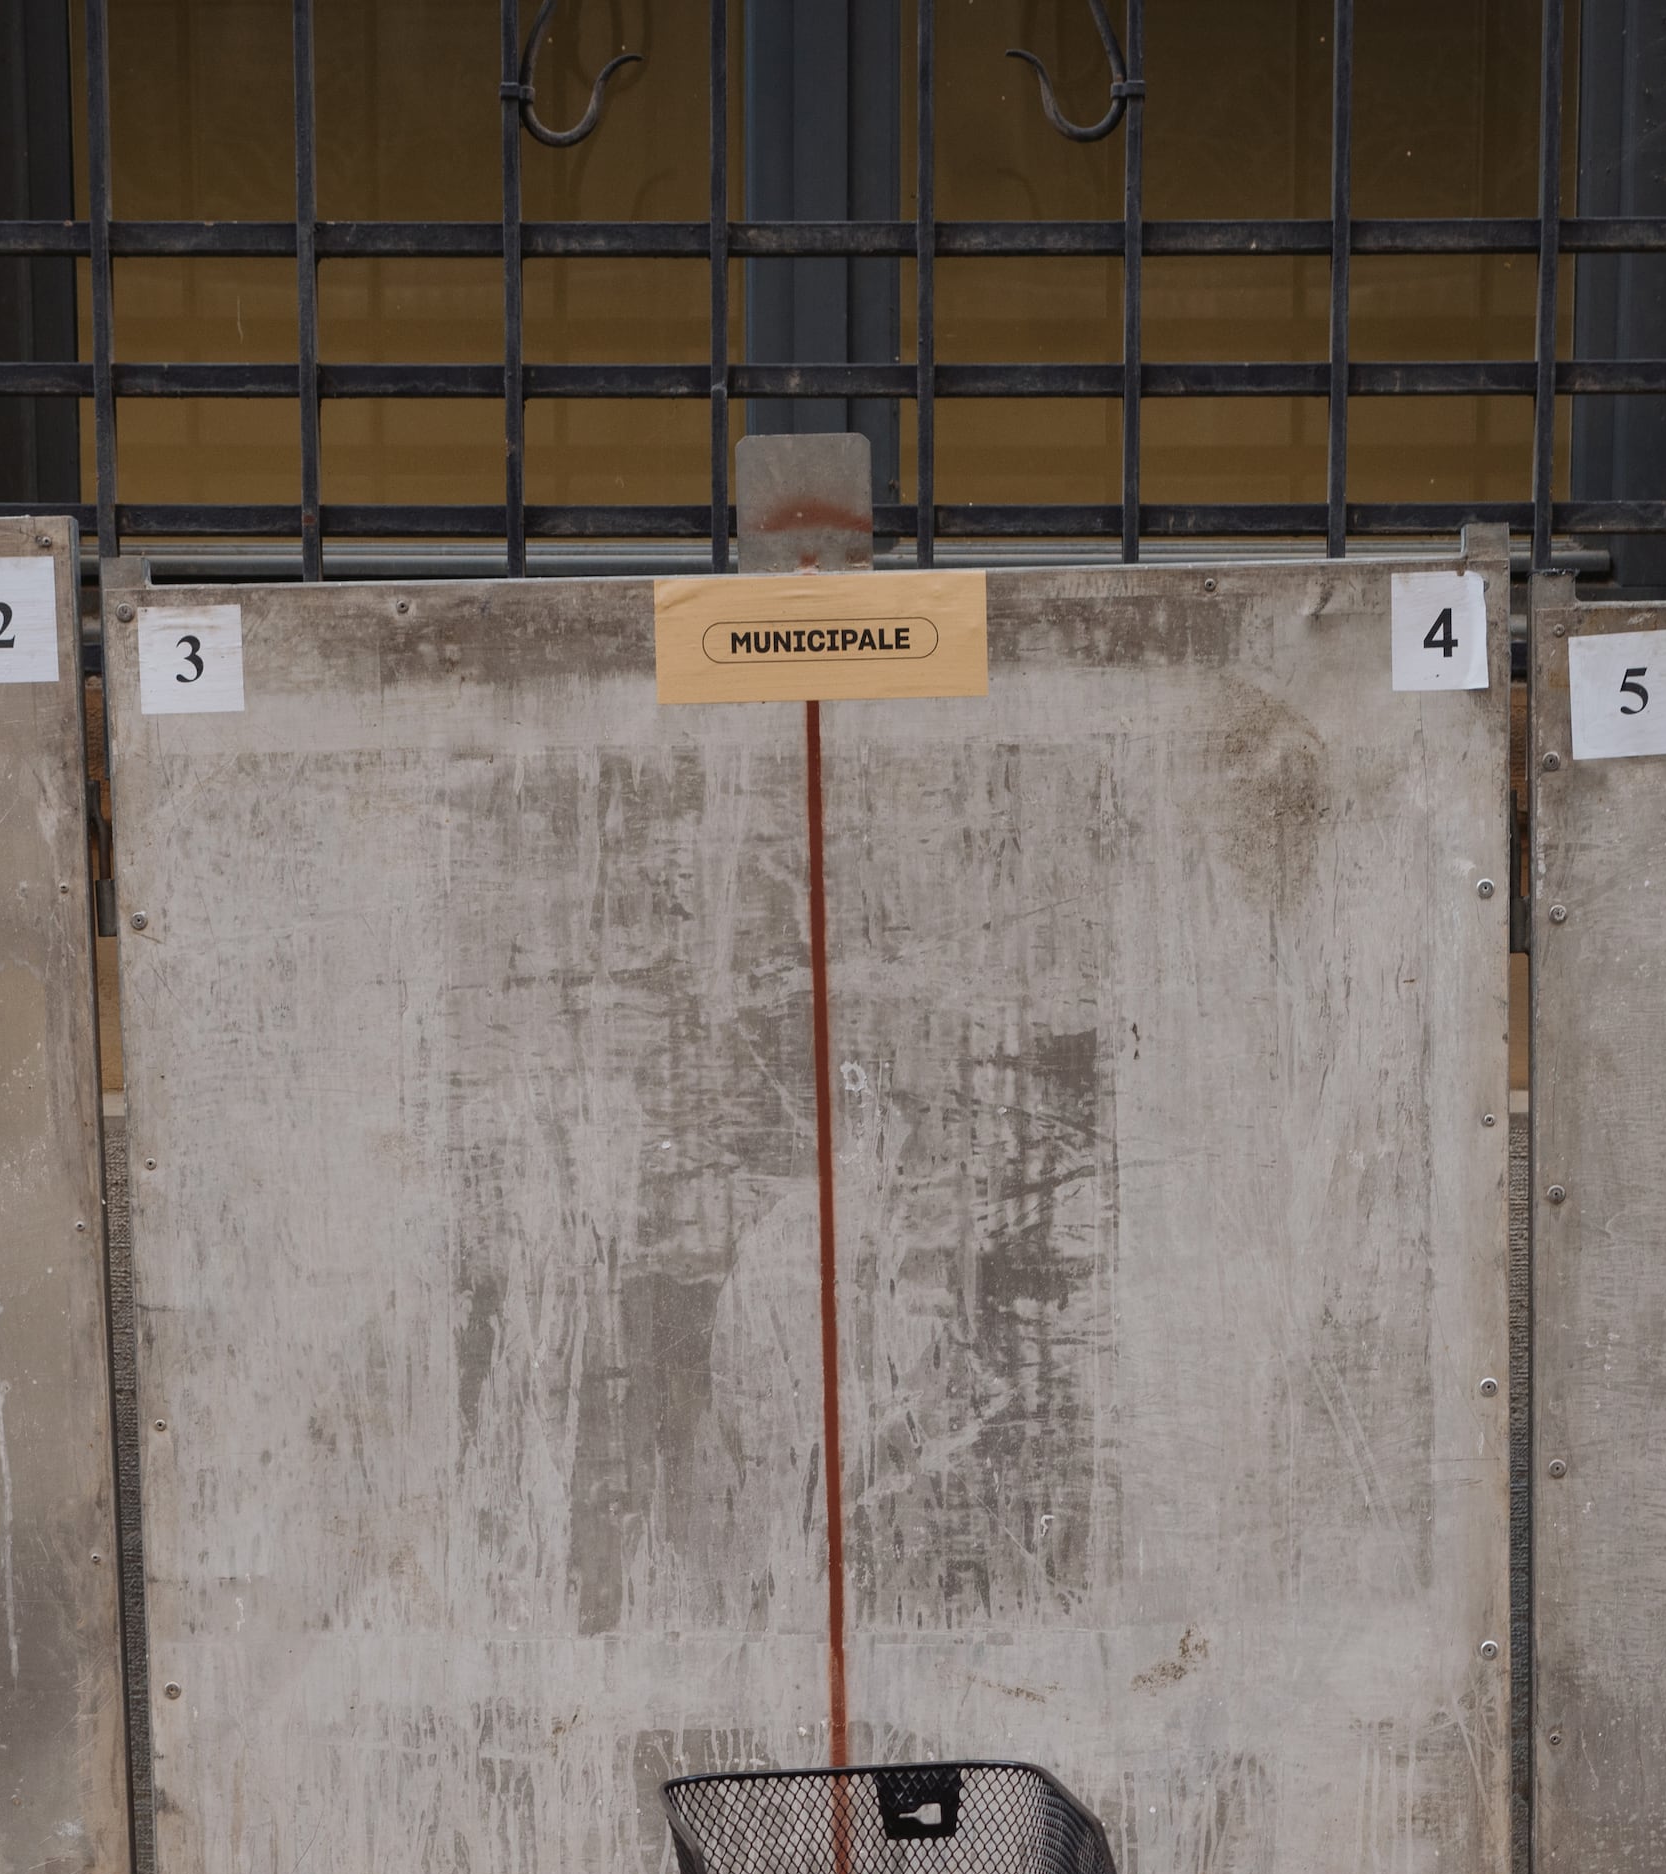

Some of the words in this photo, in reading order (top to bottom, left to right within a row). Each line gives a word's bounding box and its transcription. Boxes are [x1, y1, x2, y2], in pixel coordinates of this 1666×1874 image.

[730, 627, 911, 654] MUNICIPALE
[1423, 607, 1459, 658] 4
[175, 634, 204, 683] 3
[1619, 667, 1649, 715] 5
